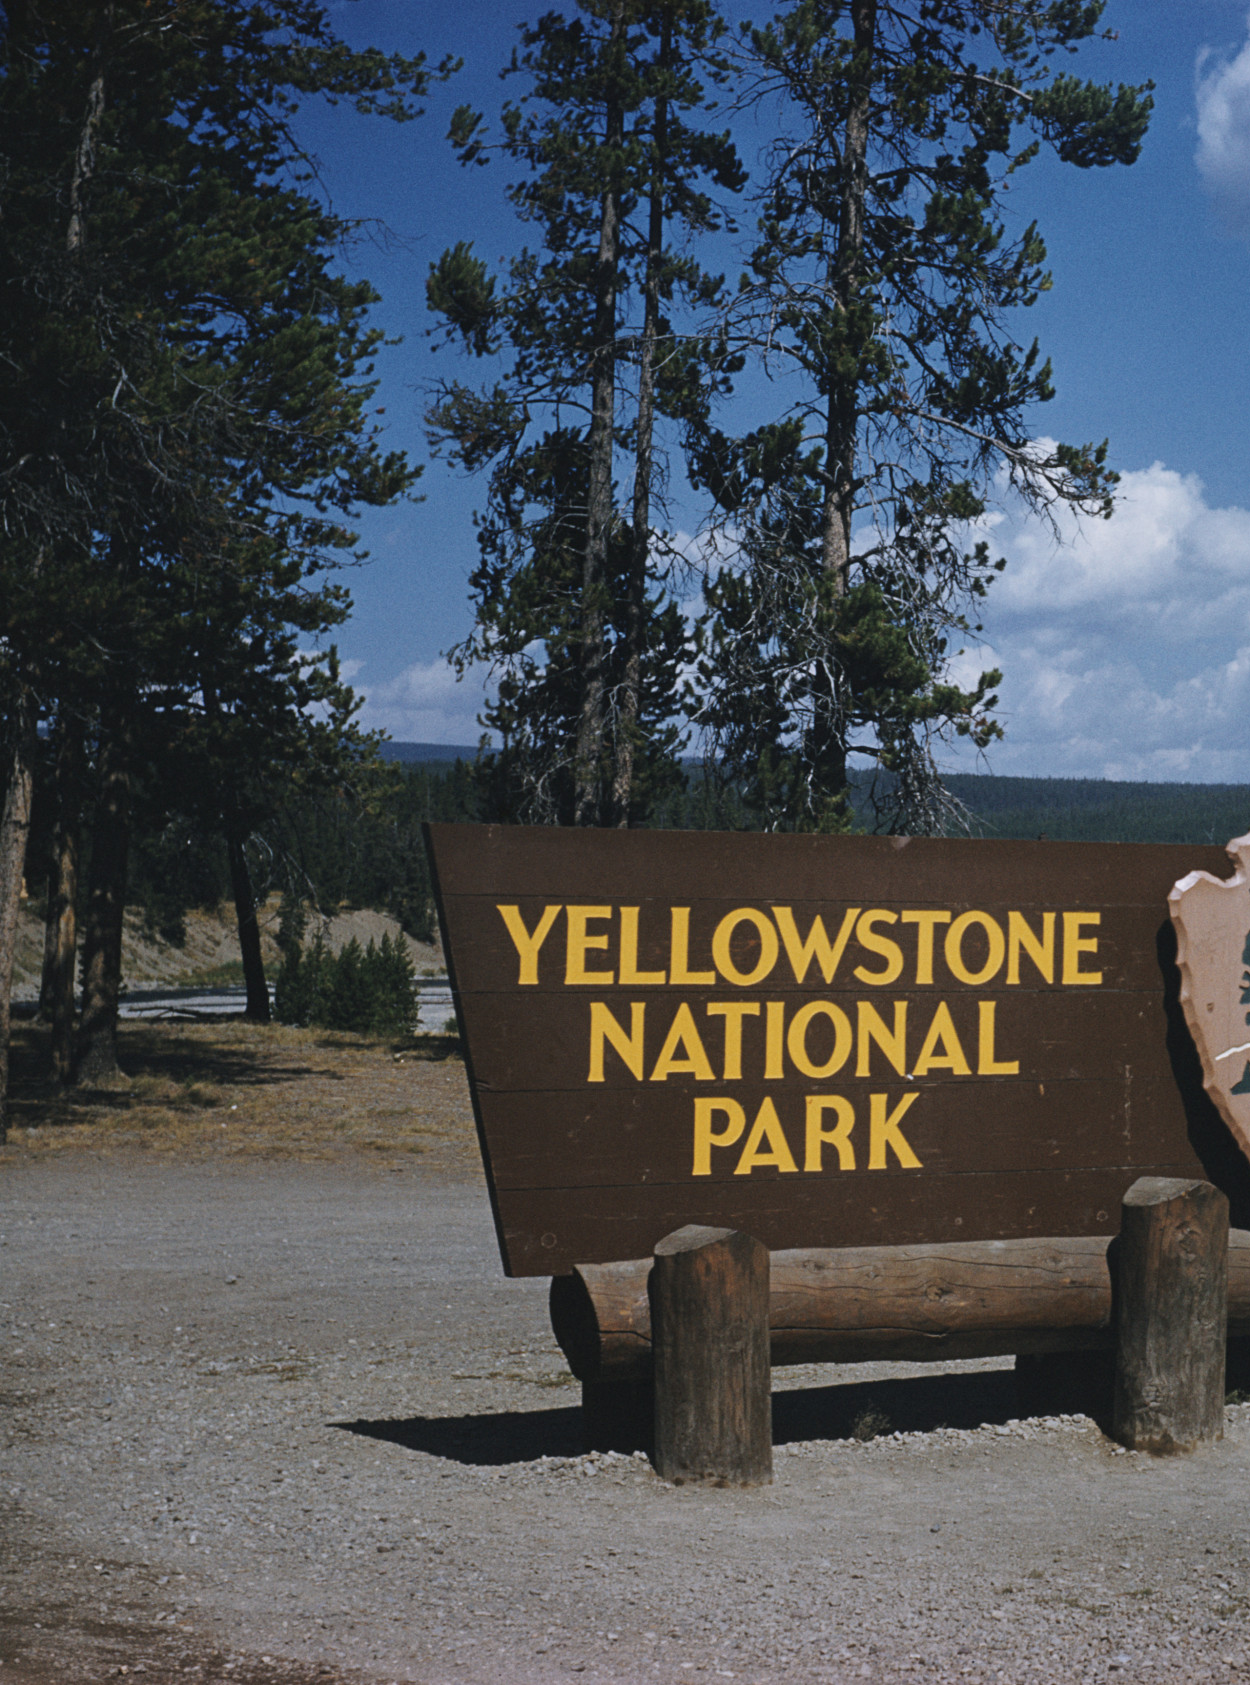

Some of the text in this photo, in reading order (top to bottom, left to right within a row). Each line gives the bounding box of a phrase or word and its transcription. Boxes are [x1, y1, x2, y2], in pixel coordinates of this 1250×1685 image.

[496, 904, 1103, 986] YELLOWSTONE
[587, 1000, 1020, 1082] NATIONAL
[692, 1093, 923, 1175] PARK
